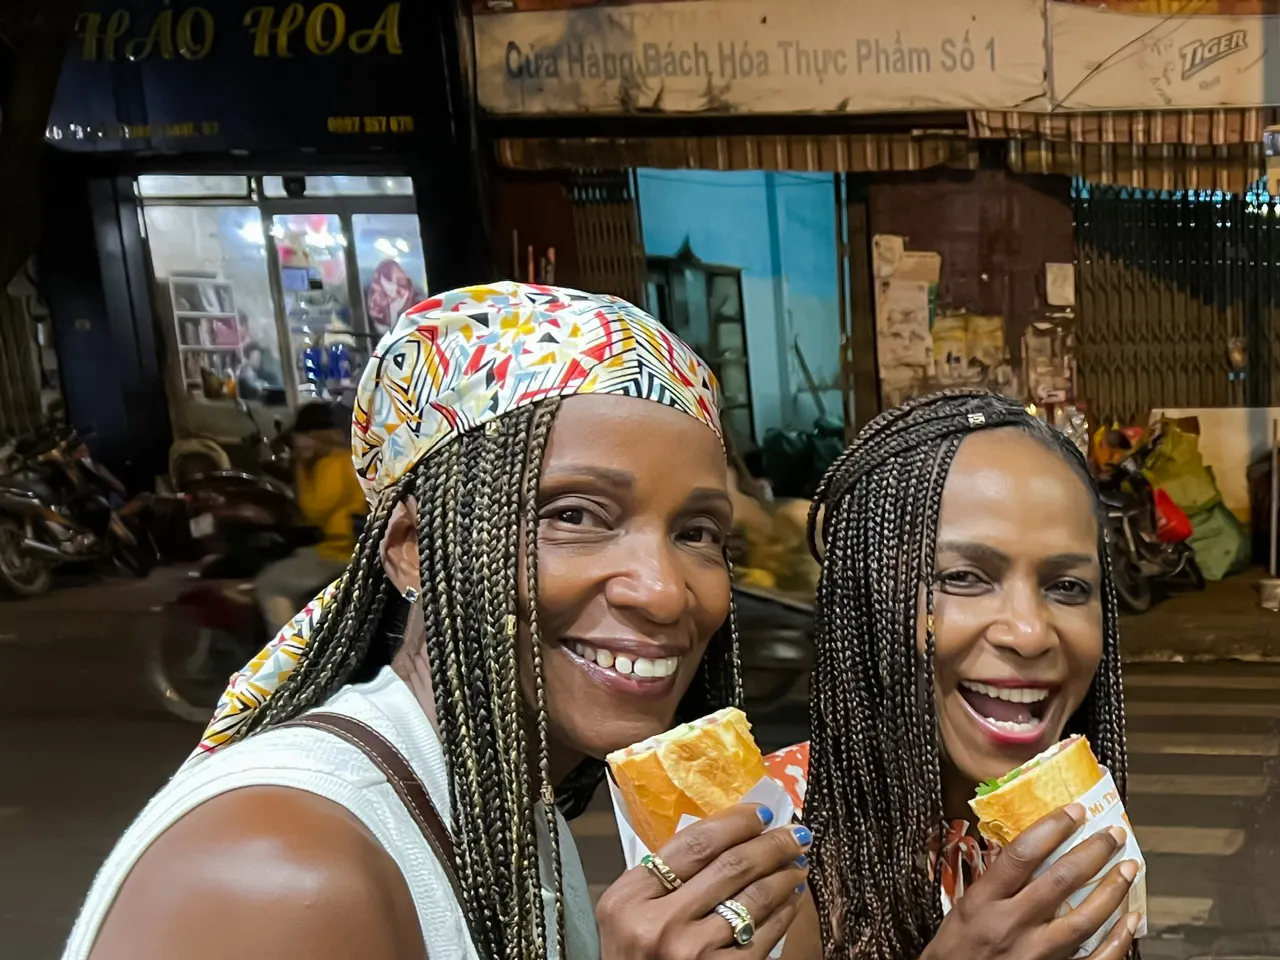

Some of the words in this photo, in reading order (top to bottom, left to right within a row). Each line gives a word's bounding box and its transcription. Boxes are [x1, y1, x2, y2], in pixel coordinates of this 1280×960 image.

[242, 1, 404, 59] HOA
[505, 40, 559, 80] Cửa
[642, 41, 709, 78] Bách
[717, 41, 770, 80] Hóa
[777, 39, 848, 86] Thực
[856, 29, 931, 75] Phẩm
[940, 28, 975, 73] Số
[985, 36, 997, 73] 1
[1179, 29, 1249, 76] TIGER
